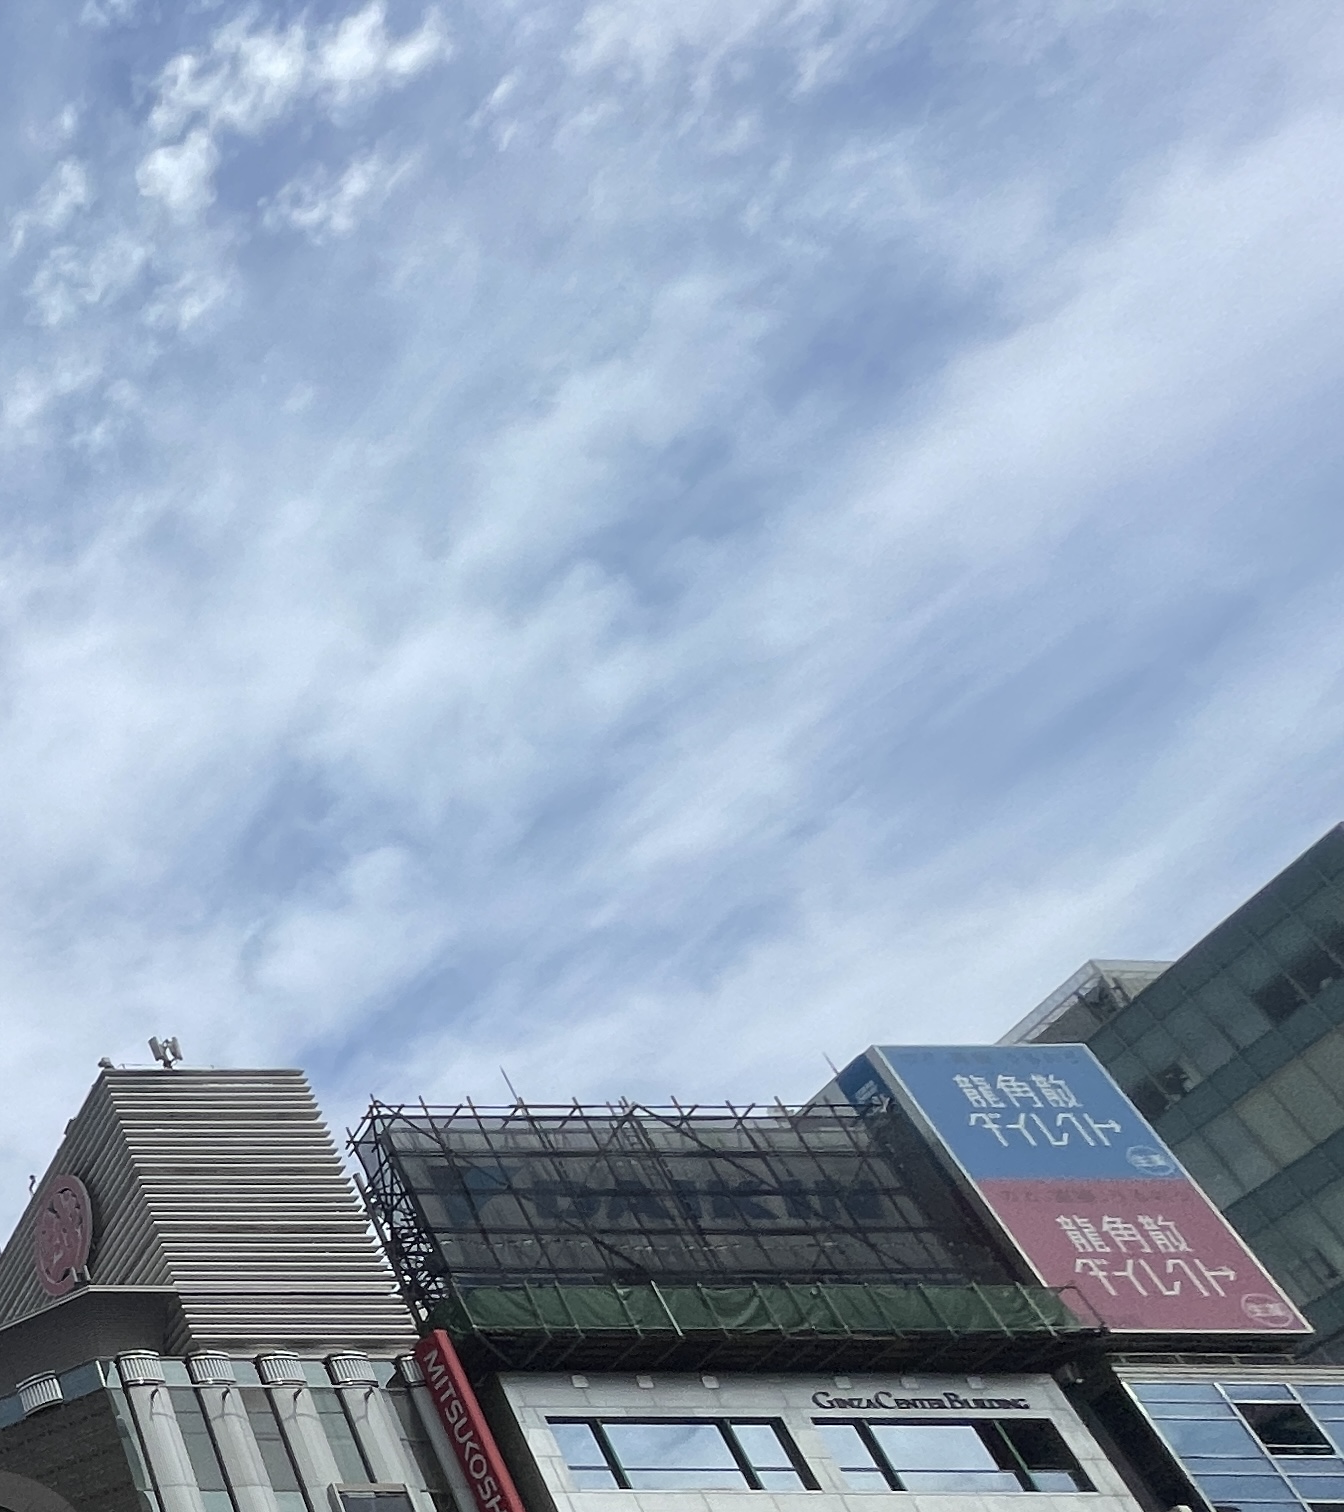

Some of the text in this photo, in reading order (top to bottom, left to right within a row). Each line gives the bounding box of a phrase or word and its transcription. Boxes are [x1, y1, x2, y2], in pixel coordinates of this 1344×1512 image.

[953, 1073, 1084, 1108] 龍角散
[968, 1111, 1122, 1147] ダイレクト
[1055, 1213, 1194, 1253] 龍角散
[1074, 1258, 1237, 1297] ダイレクト
